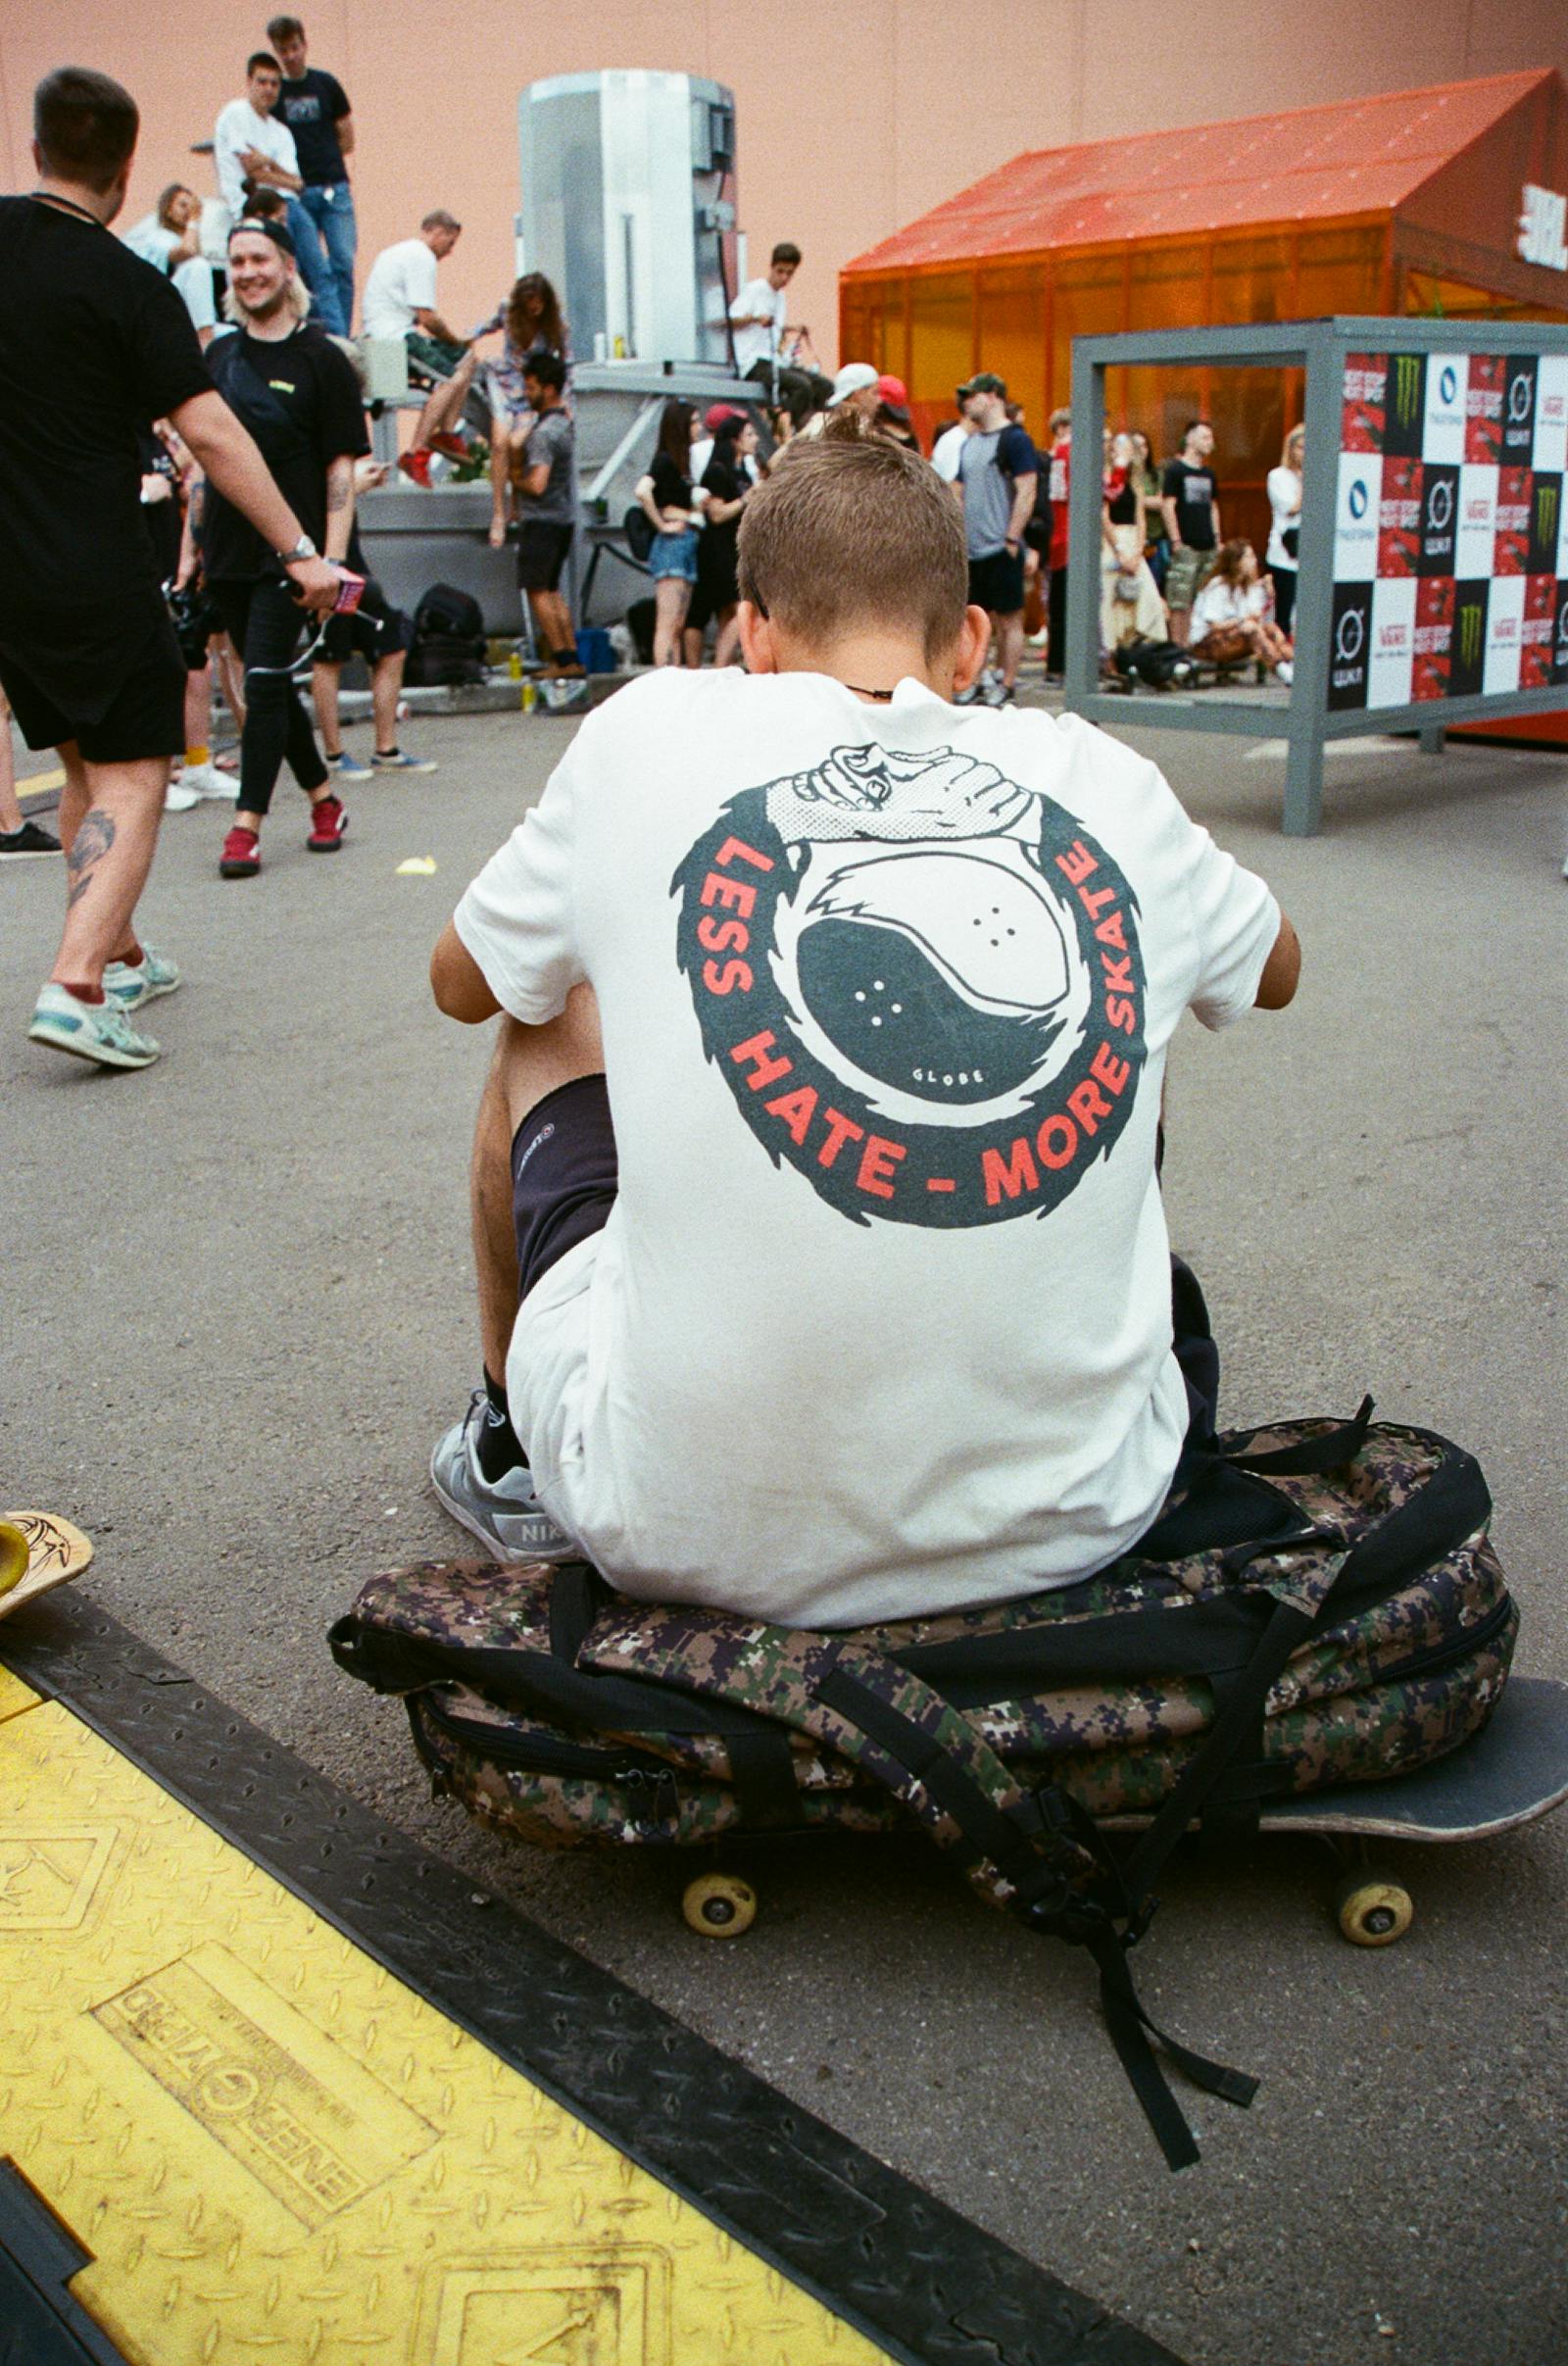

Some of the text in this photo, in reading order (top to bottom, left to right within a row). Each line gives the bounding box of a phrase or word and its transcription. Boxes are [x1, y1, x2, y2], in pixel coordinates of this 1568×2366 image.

[697, 837, 774, 995] LESS
[1056, 841, 1136, 1035] SKATE
[730, 1030, 906, 1200] HATE
[912, 1067, 984, 1087] GLOBE
[982, 1042, 1130, 1206] MORE
[521, 1524, 565, 1542] NIK
